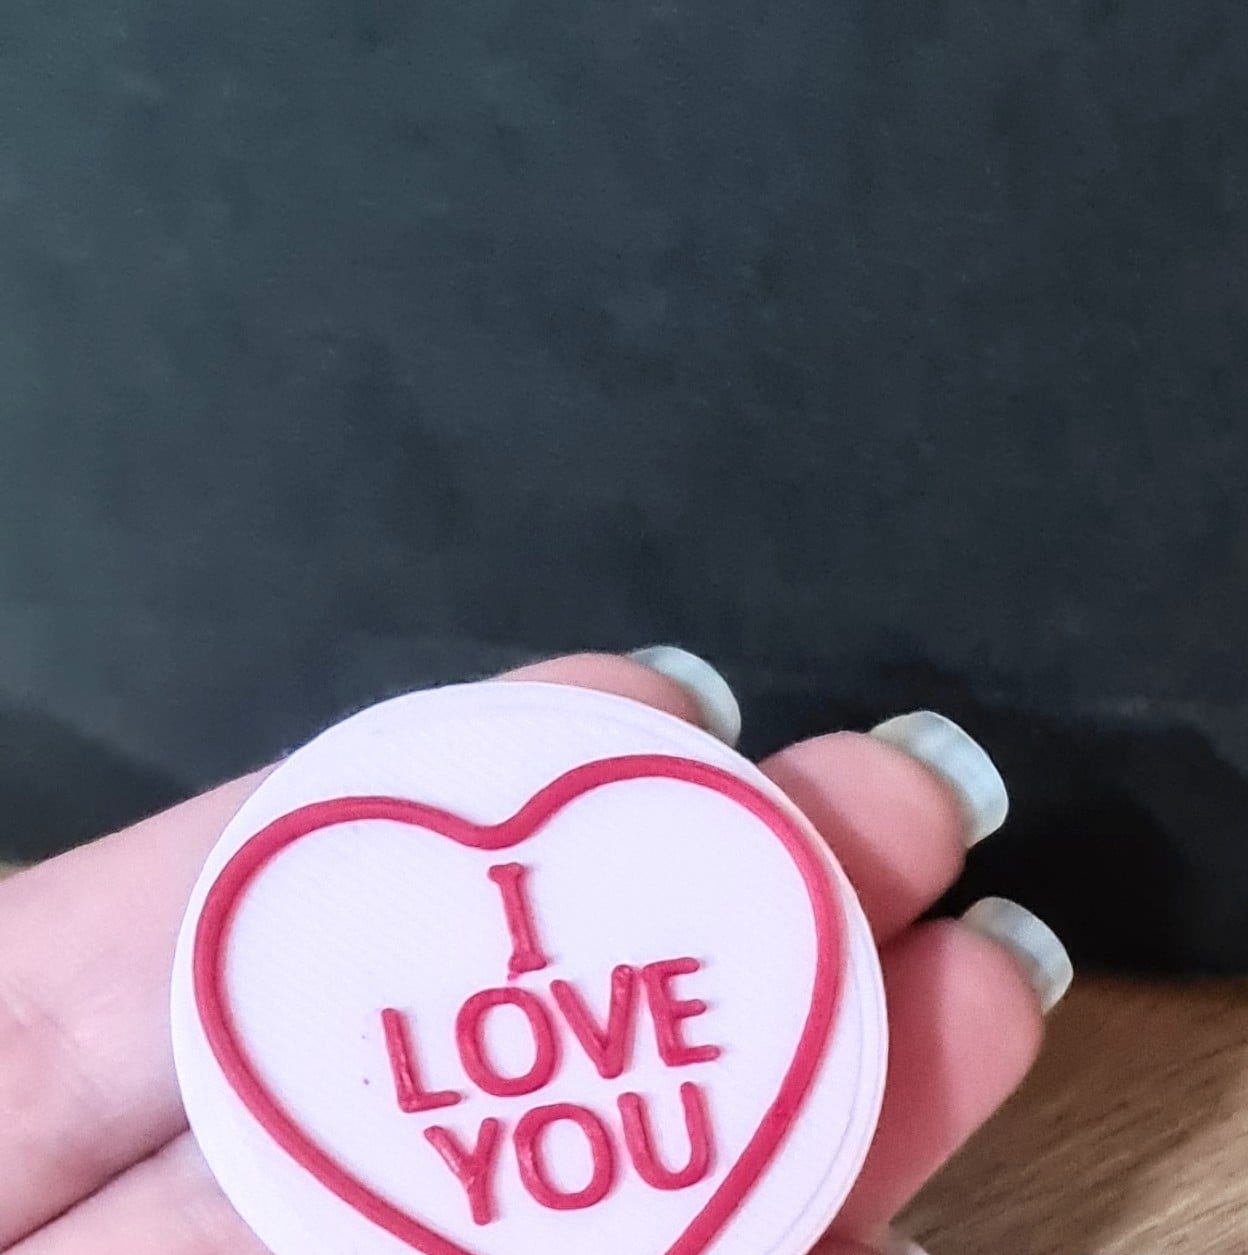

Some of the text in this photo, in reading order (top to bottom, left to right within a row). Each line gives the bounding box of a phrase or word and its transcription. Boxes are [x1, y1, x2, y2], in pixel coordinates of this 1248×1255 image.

[488, 862, 547, 980] I
[381, 957, 720, 1113] LOVE
[424, 1081, 714, 1226] YOU
